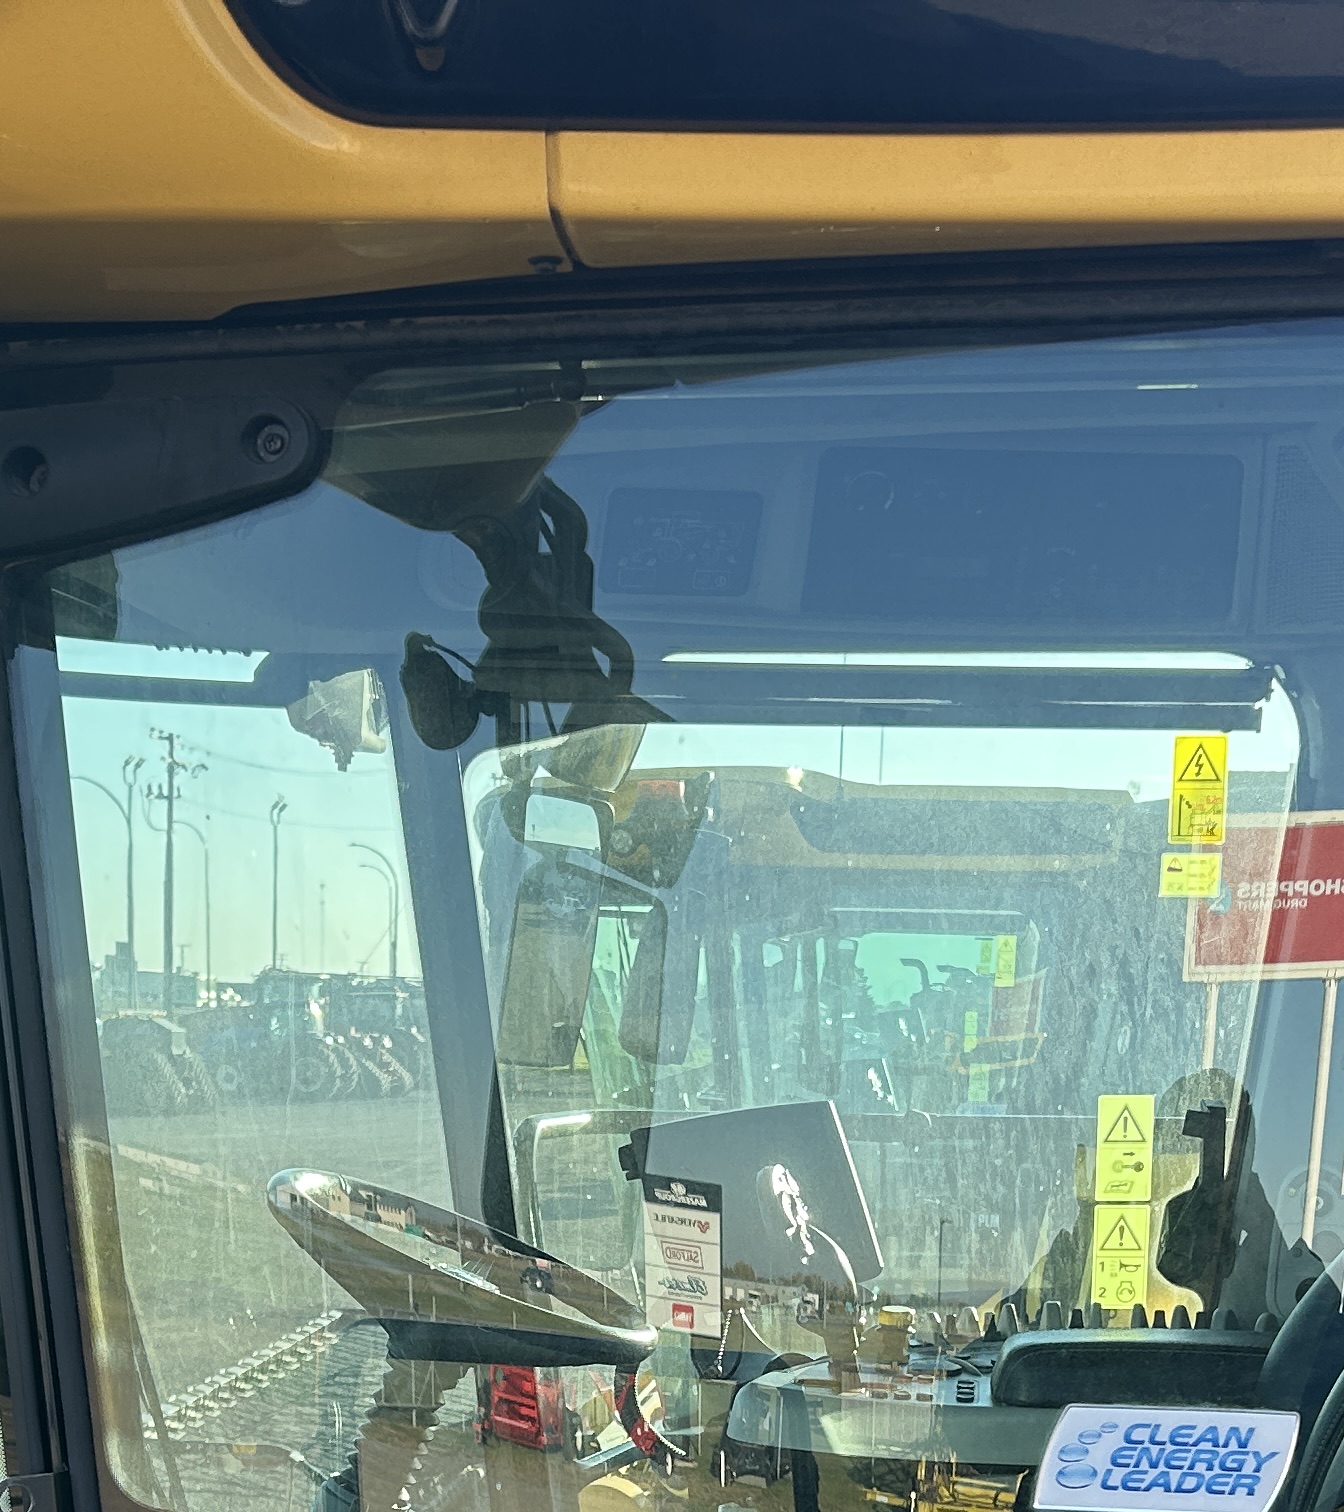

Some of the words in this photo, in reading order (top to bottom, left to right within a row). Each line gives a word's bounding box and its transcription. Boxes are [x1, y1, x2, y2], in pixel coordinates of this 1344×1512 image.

[1098, 1261, 1105, 1272] 1
[1098, 1287, 1107, 1298] 2
[1123, 1423, 1256, 1449] CLEAN
[1110, 1446, 1280, 1473] ENERGY
[1100, 1469, 1263, 1496] LEADER
